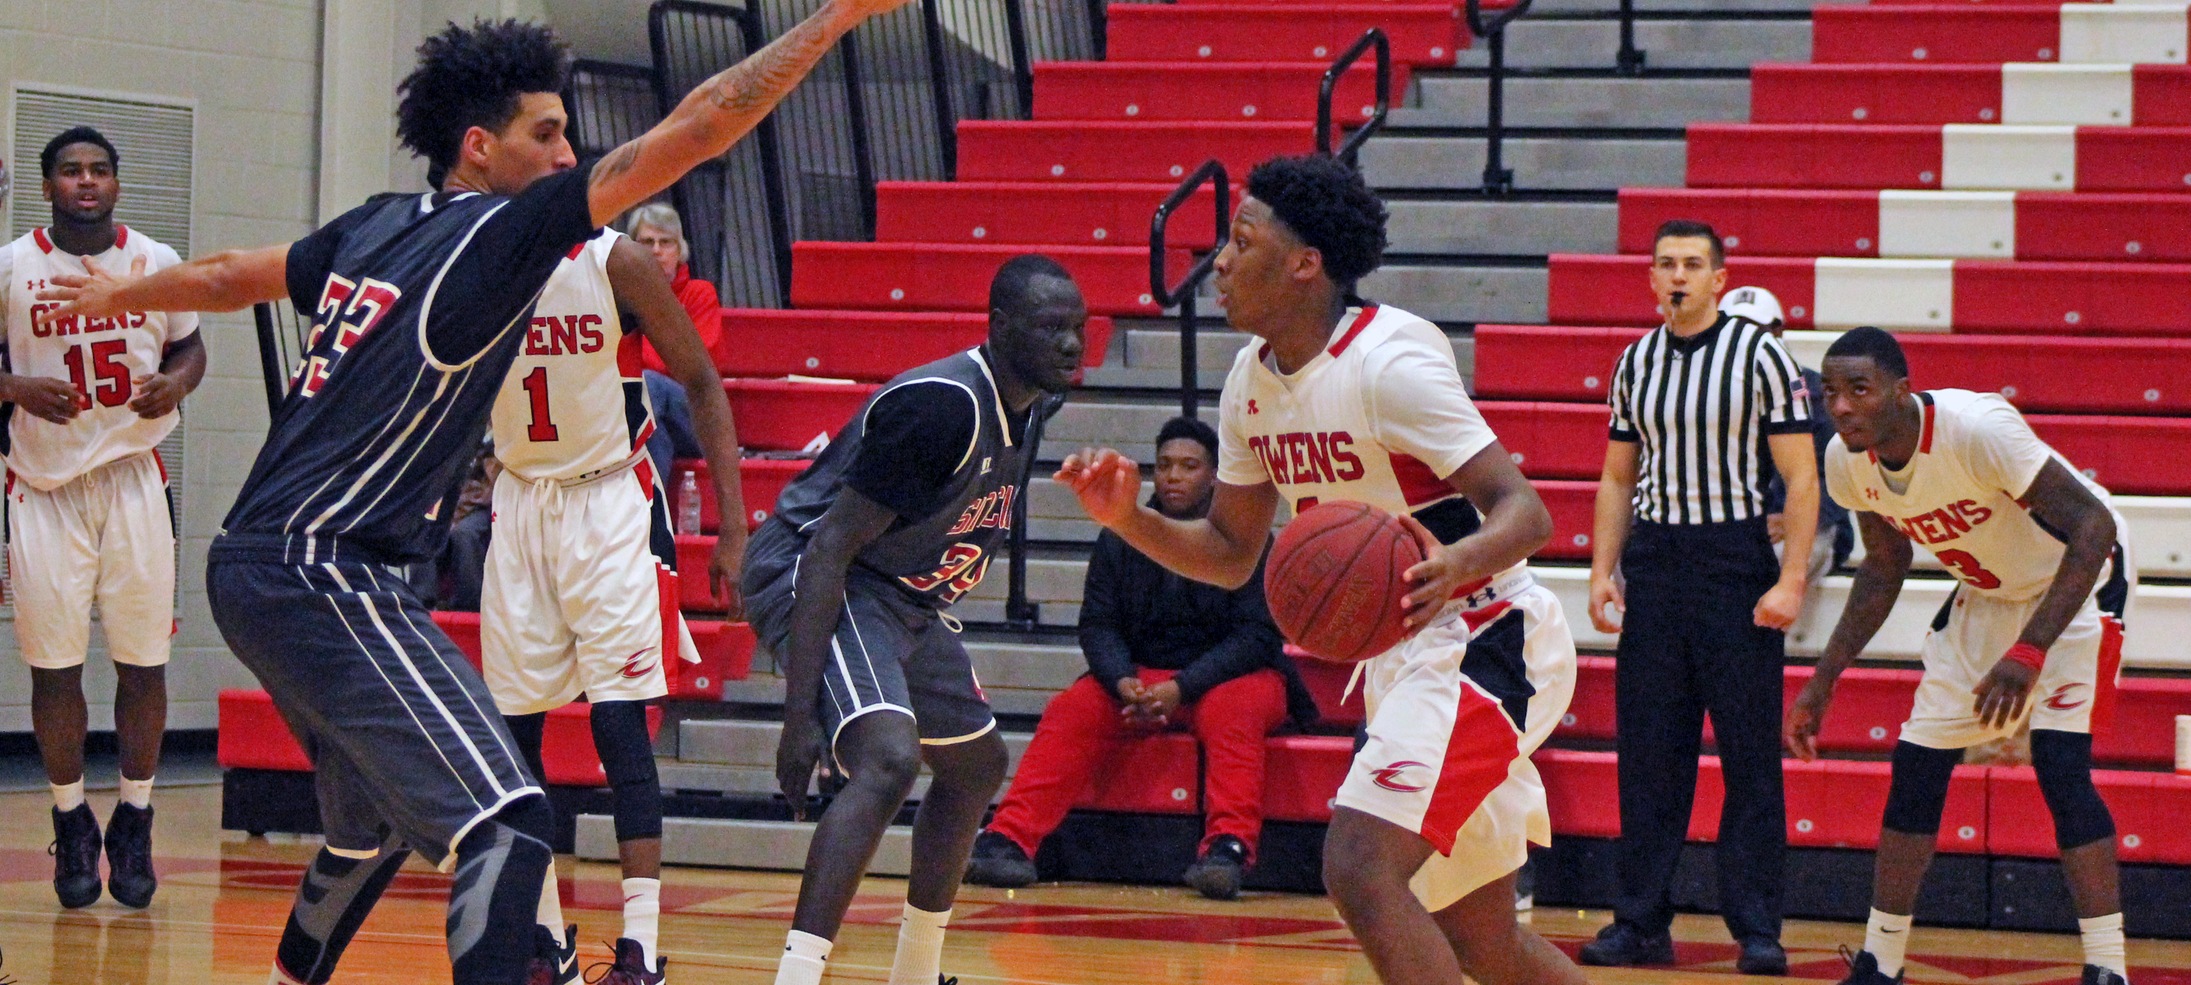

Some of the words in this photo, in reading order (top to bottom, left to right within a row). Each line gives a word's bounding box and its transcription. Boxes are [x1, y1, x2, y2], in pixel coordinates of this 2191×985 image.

[515, 314, 604, 355] ENS
[64, 339, 132, 411] 15
[522, 367, 559, 442] 1
[1249, 431, 1365, 485] OWENS
[1883, 499, 1992, 545] WENS
[1934, 548, 2001, 590] 3
